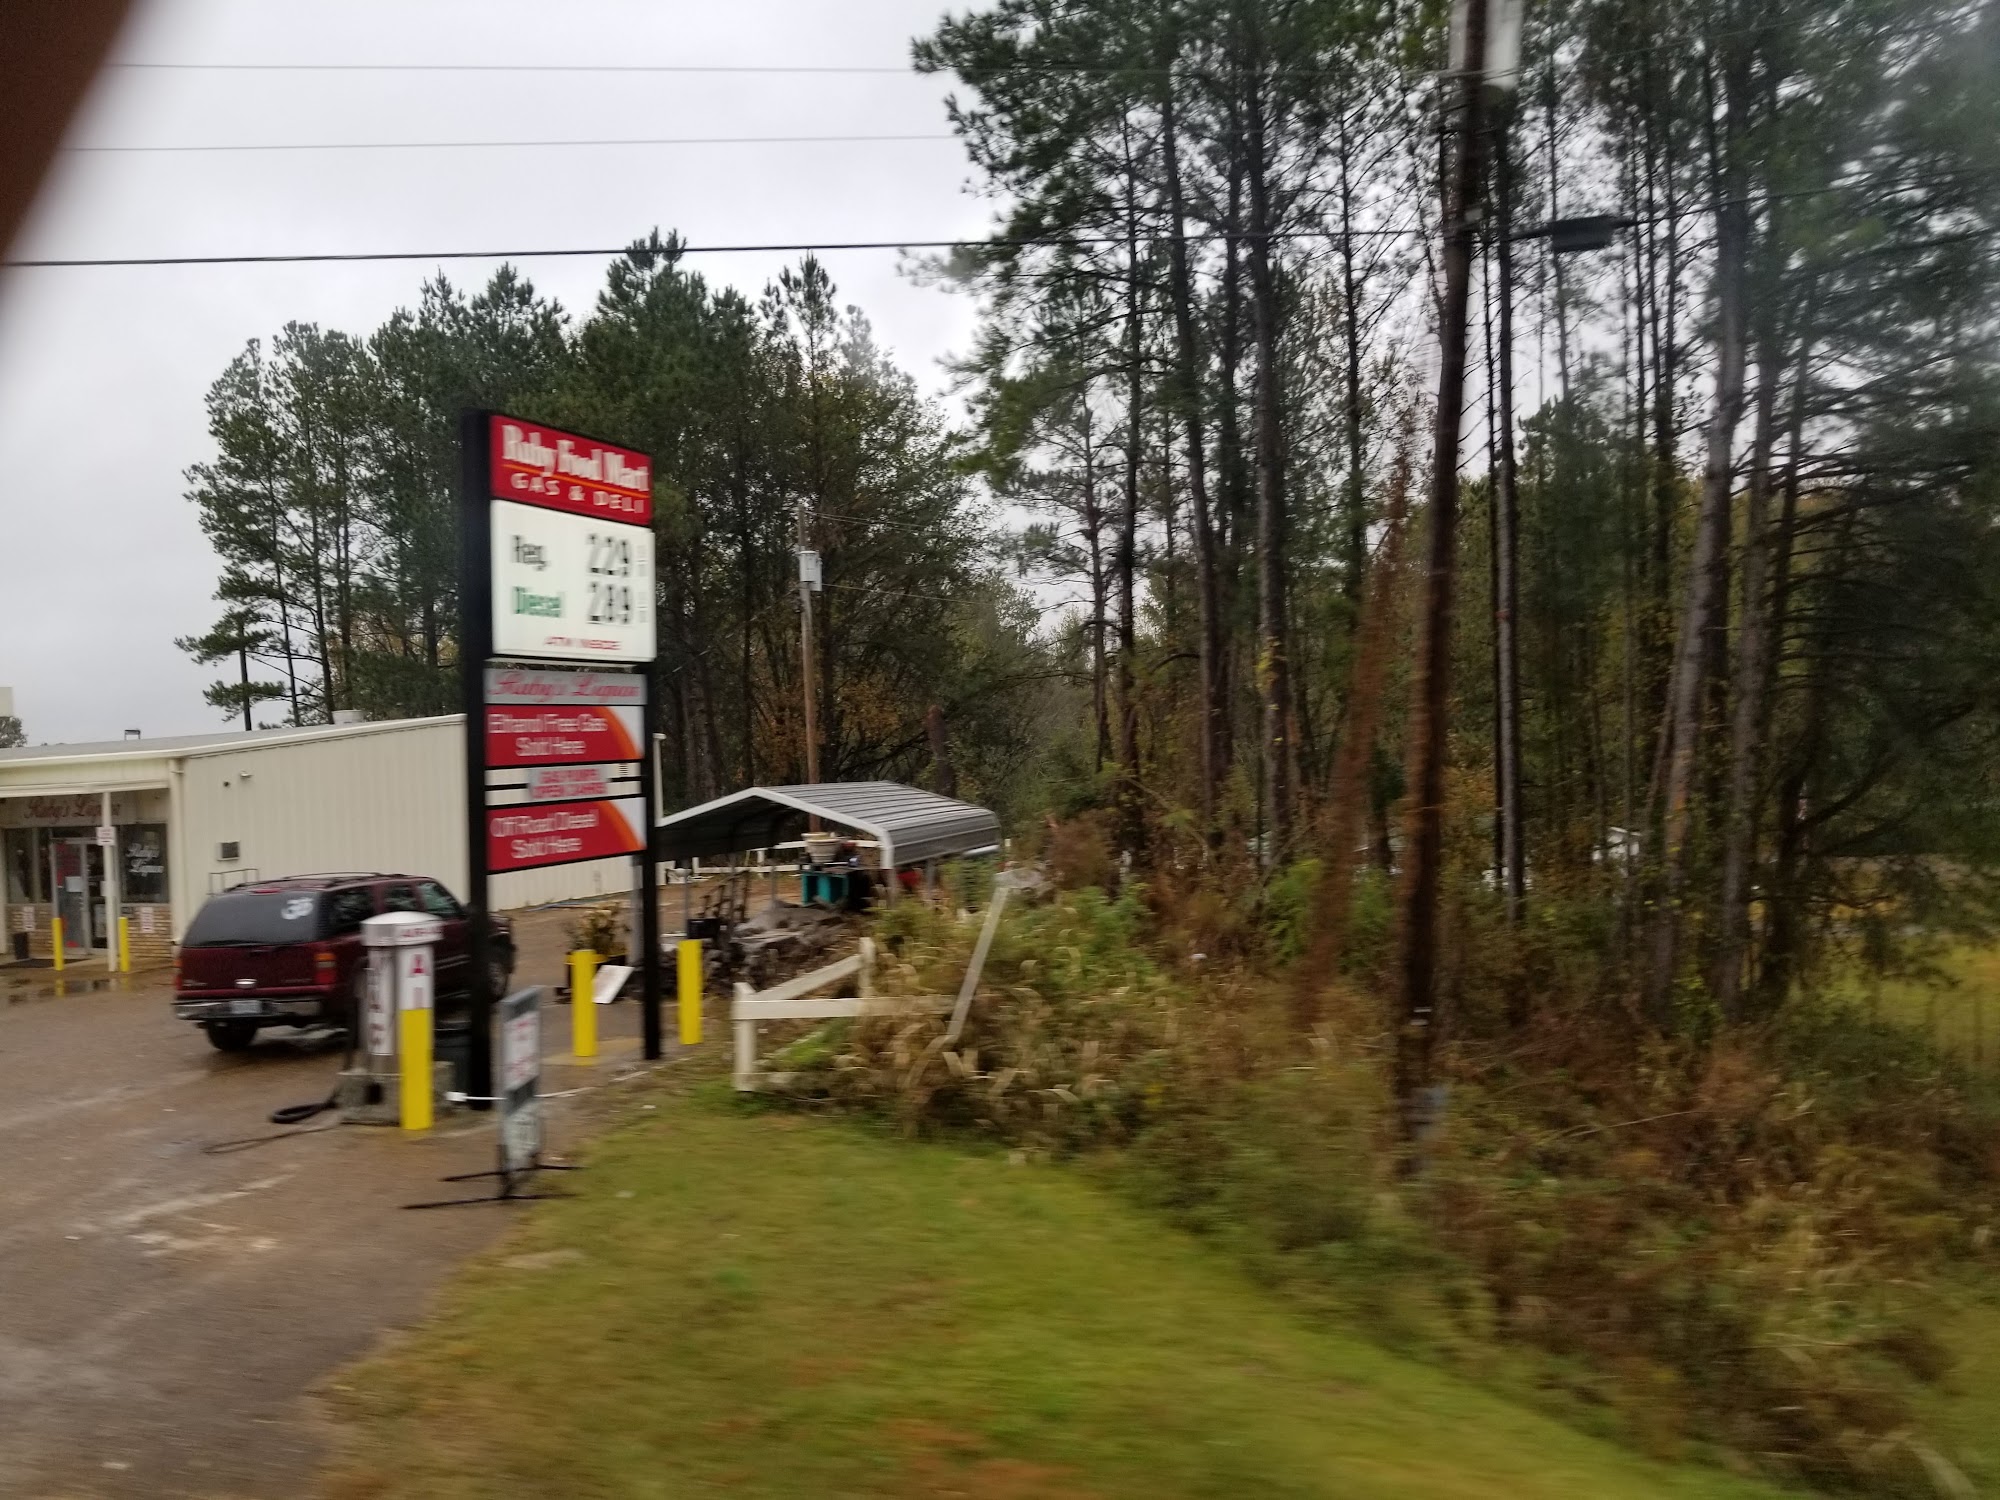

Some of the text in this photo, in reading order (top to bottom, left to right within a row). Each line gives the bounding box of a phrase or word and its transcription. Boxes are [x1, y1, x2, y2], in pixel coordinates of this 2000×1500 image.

[501, 425, 650, 491] Ruby Food Mart
[510, 472, 645, 513] GAS & DELI
[577, 713, 608, 733] Gas
